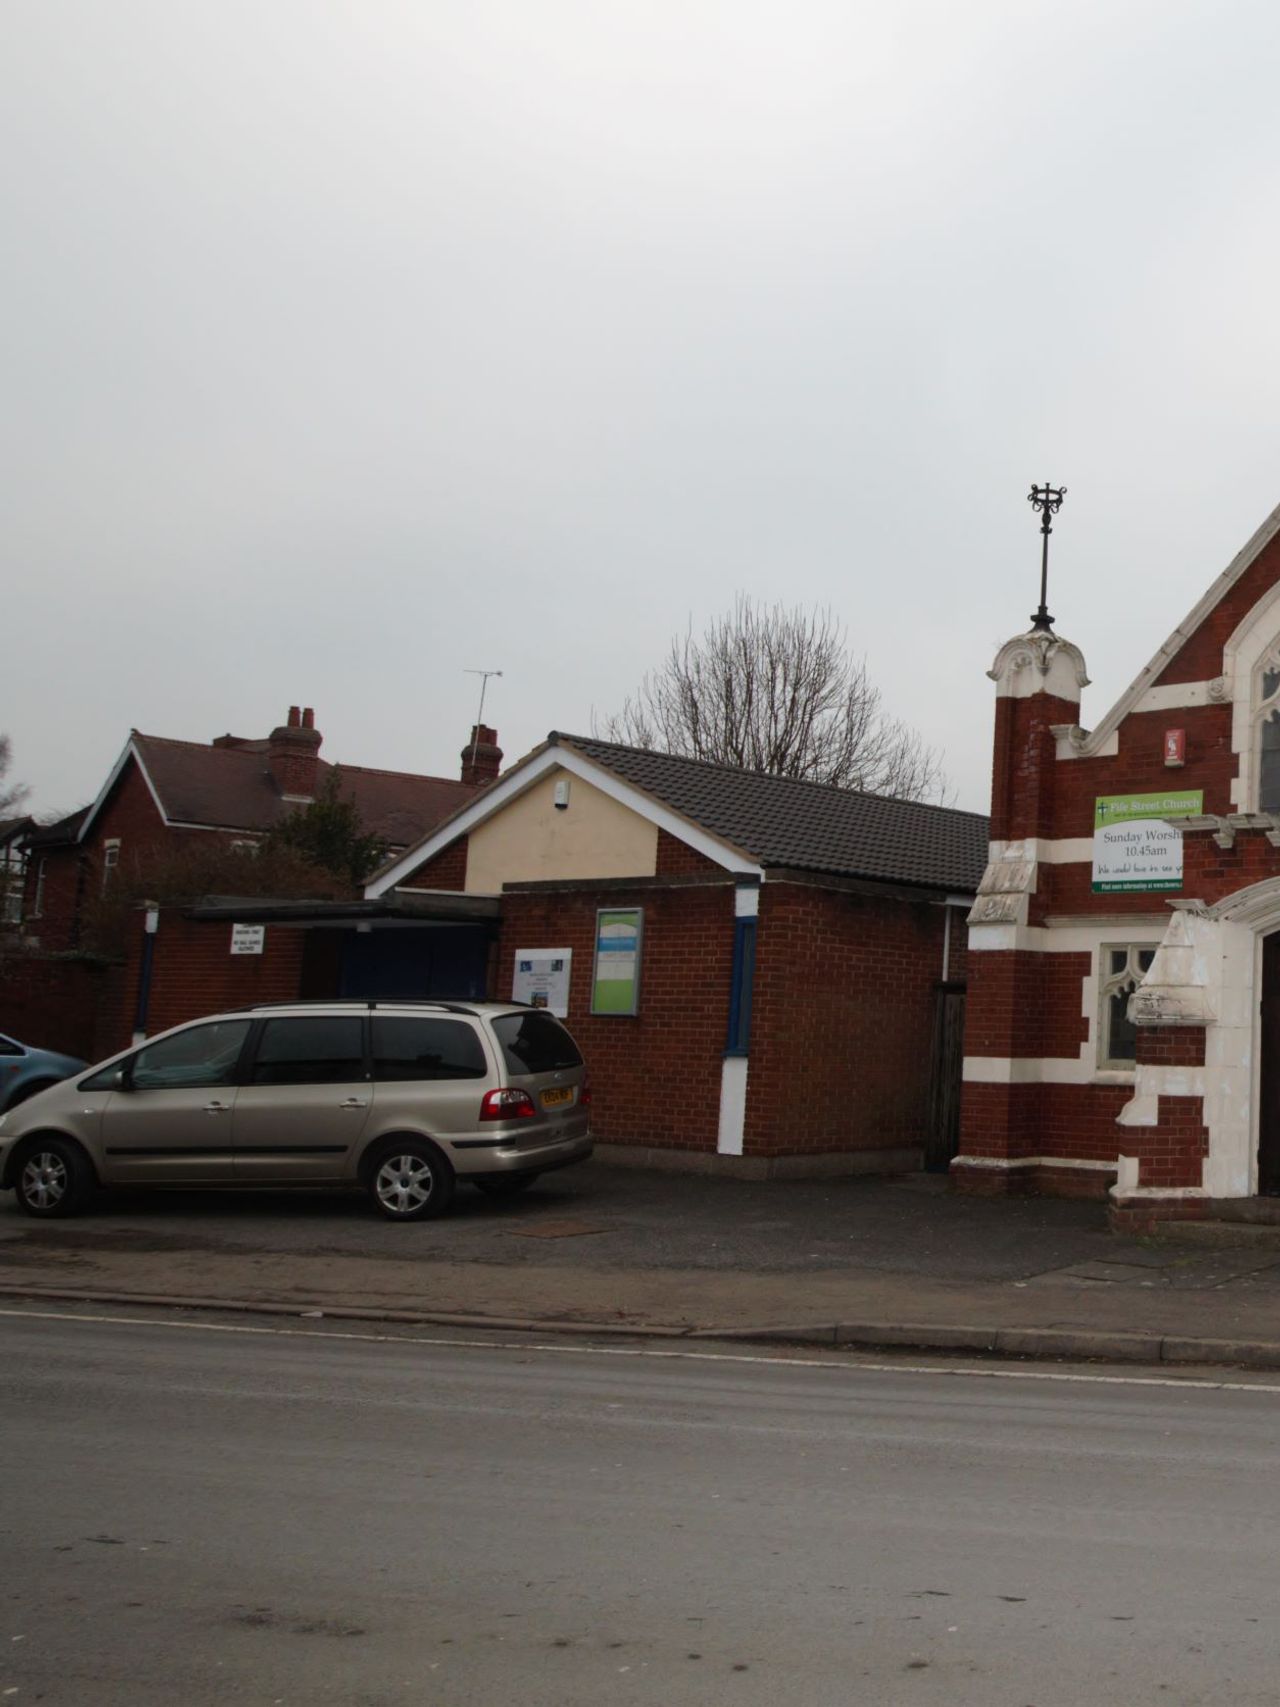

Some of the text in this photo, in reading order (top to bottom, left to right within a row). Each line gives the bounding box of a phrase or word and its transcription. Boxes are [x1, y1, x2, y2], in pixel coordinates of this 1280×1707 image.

[1131, 800, 1160, 811] Street
[1163, 798, 1200, 809] Church
[1104, 831, 1143, 845] Sunday
[1125, 845, 1168, 857] 10.45am
